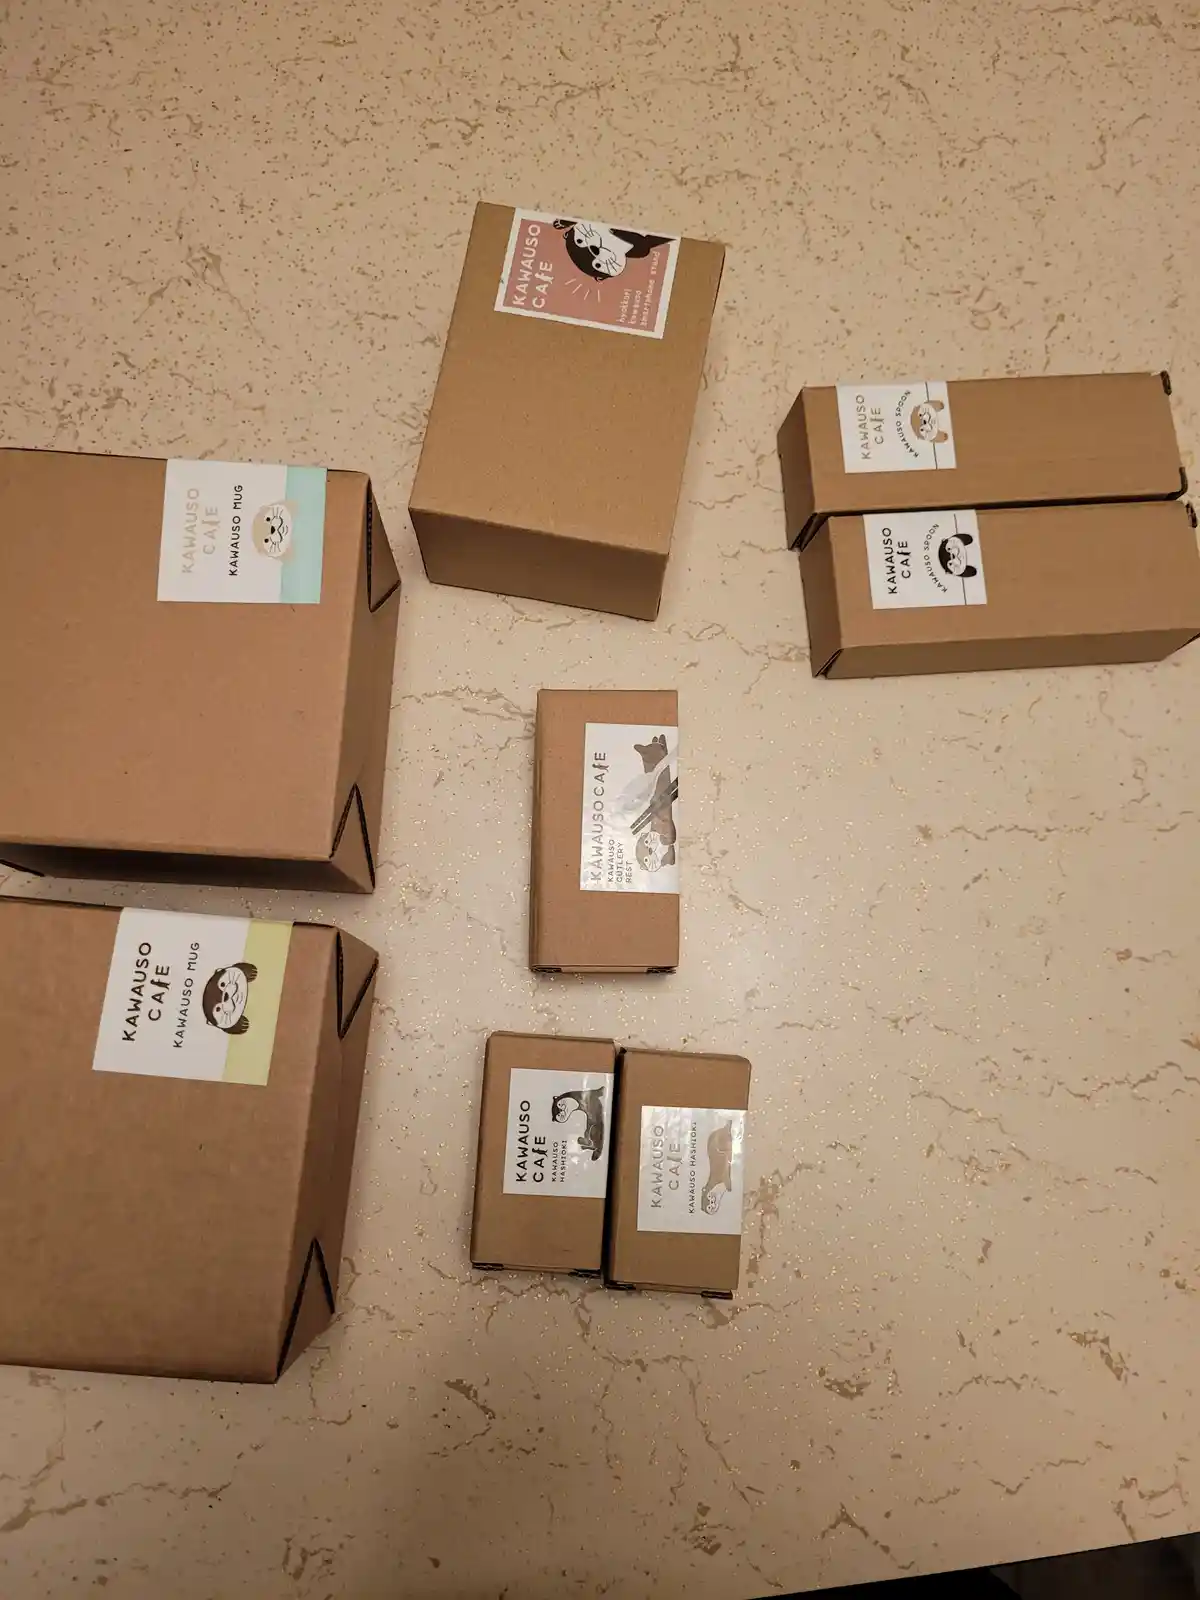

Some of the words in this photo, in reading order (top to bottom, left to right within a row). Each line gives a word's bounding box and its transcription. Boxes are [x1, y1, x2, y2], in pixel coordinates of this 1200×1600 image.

[512, 224, 541, 305] KAWAUSO
[855, 394, 872, 460] KAWAUSO
[895, 390, 911, 417] SPOON
[896, 421, 919, 458] KAWAUSO
[233, 485, 243, 510] MUG
[182, 488, 199, 574] KAWAUSO
[228, 515, 241, 576] KAWAUSO
[881, 527, 898, 594] KAWAUSO
[923, 523, 939, 551] SPOON
[923, 554, 948, 593] KAWAUSO
[607, 839, 615, 883] KAWAUSO
[616, 842, 625, 883] CUTLERY
[122, 942, 151, 1042] KAWAUSO
[173, 977, 194, 1048] KAWAUSO
[187, 942, 200, 971] MUG
[516, 1100, 530, 1182] KAWAUSO
[651, 1125, 664, 1208] KAWAUSO
[689, 1122, 697, 1166] HASHIOKI
